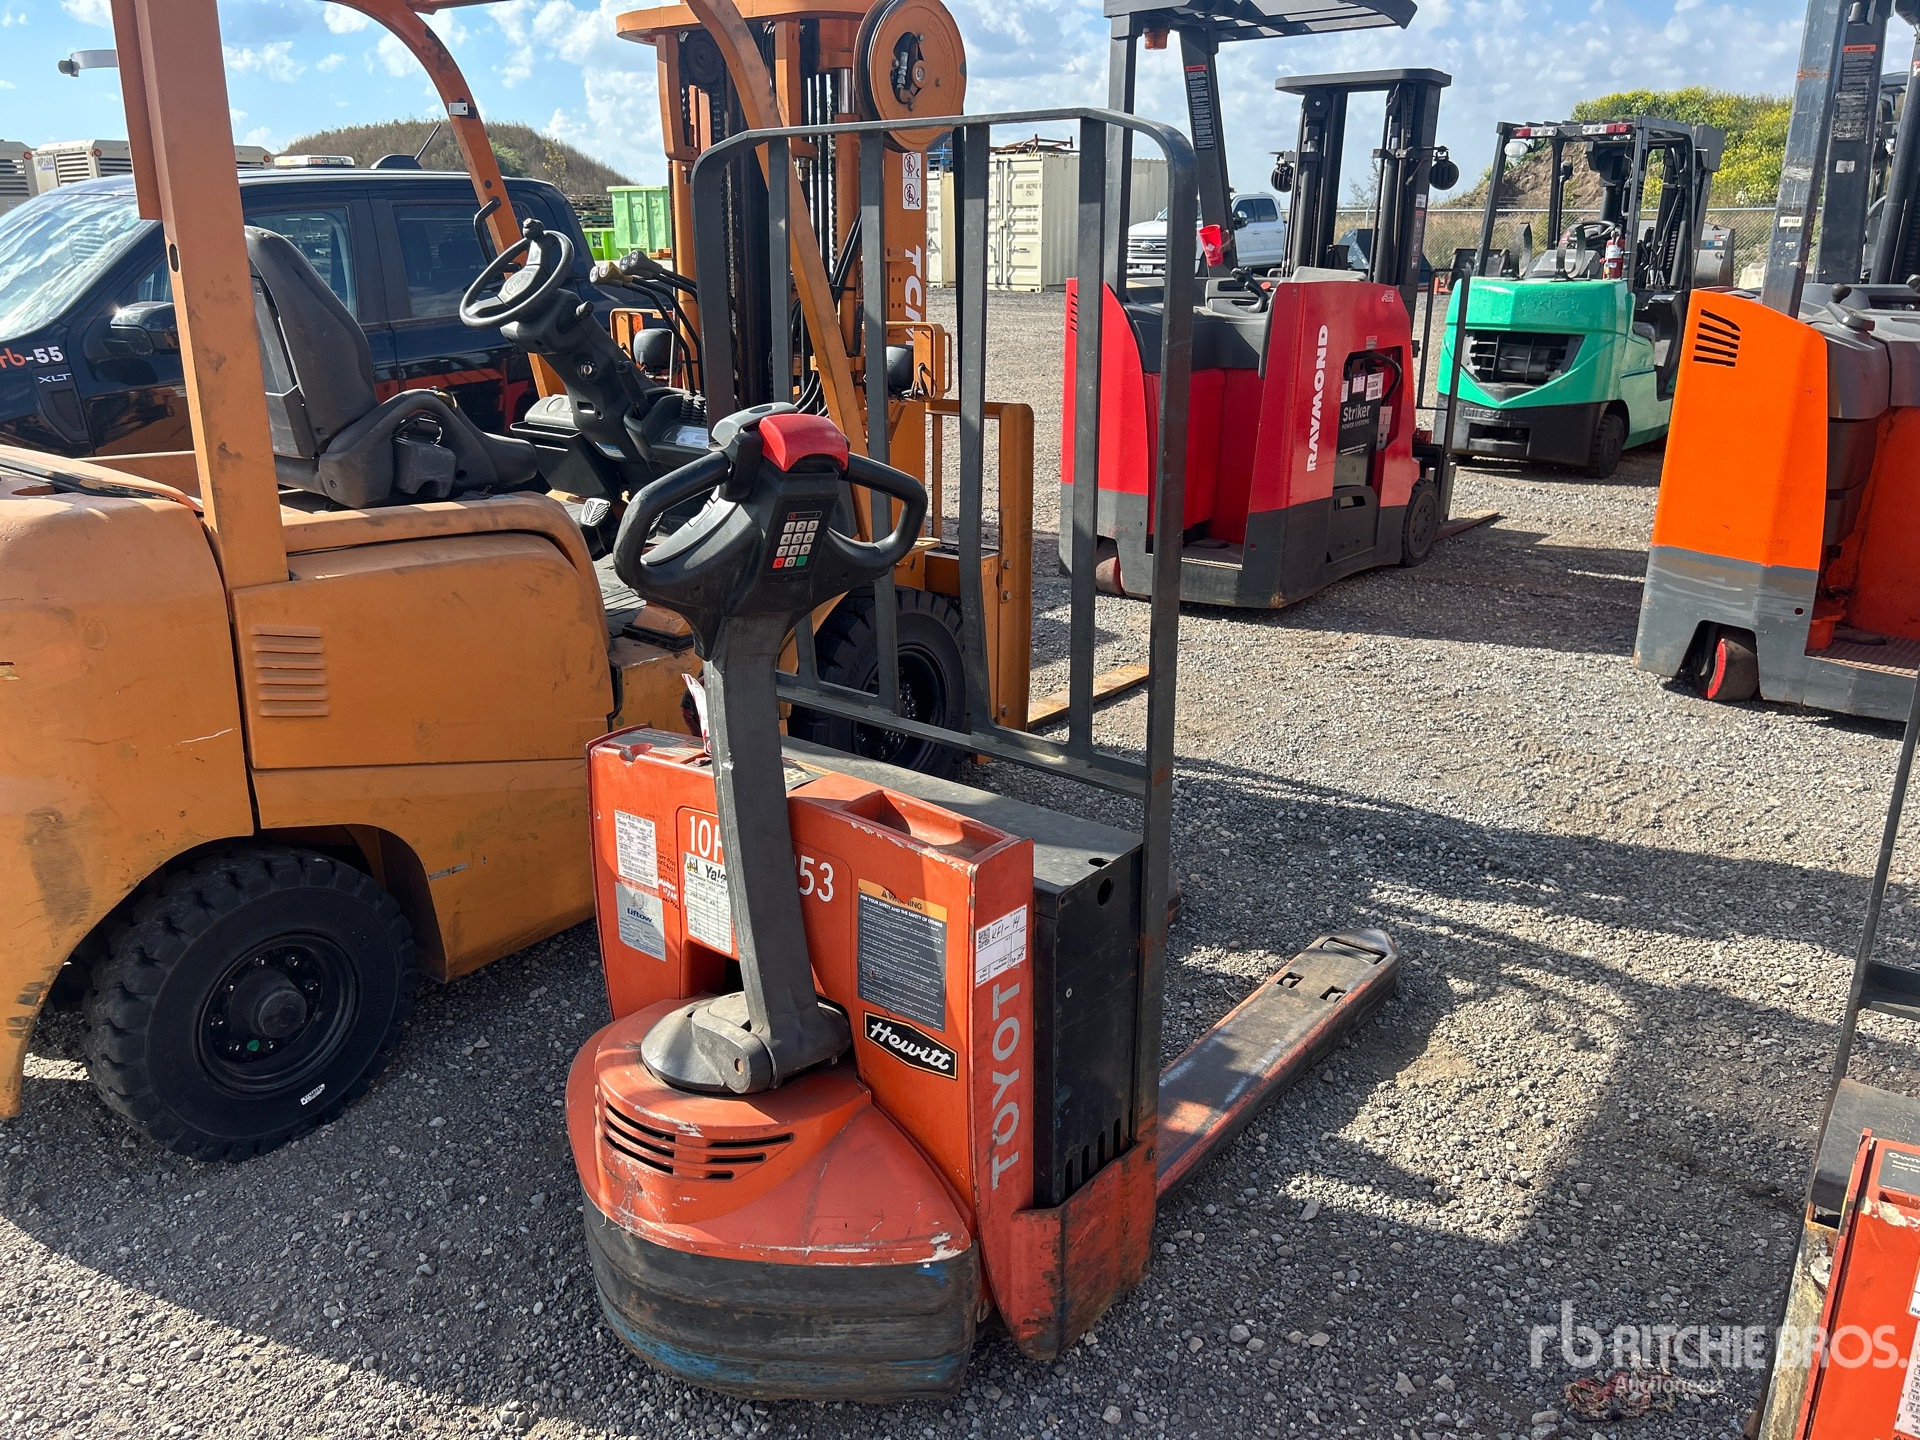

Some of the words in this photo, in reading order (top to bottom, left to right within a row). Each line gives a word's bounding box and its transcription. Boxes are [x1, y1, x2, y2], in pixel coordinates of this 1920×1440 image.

[38, 373, 72, 384] XLT
[1306, 324, 1329, 472] RAYMOND
[1342, 404, 1371, 422] Striker
[705, 864, 727, 883] Yale
[794, 854, 834, 902] 53
[627, 907, 653, 924] Liftow
[860, 894, 868, 902] FOR
[868, 897, 879, 905] YOUR
[879, 901, 891, 910] SAFETY
[891, 906, 900, 914] AND
[908, 911, 922, 921] SAFETY
[928, 918, 943, 928] OTHERS
[870, 1022, 951, 1070] Hewitt
[992, 983, 1021, 1192] TOYOT
